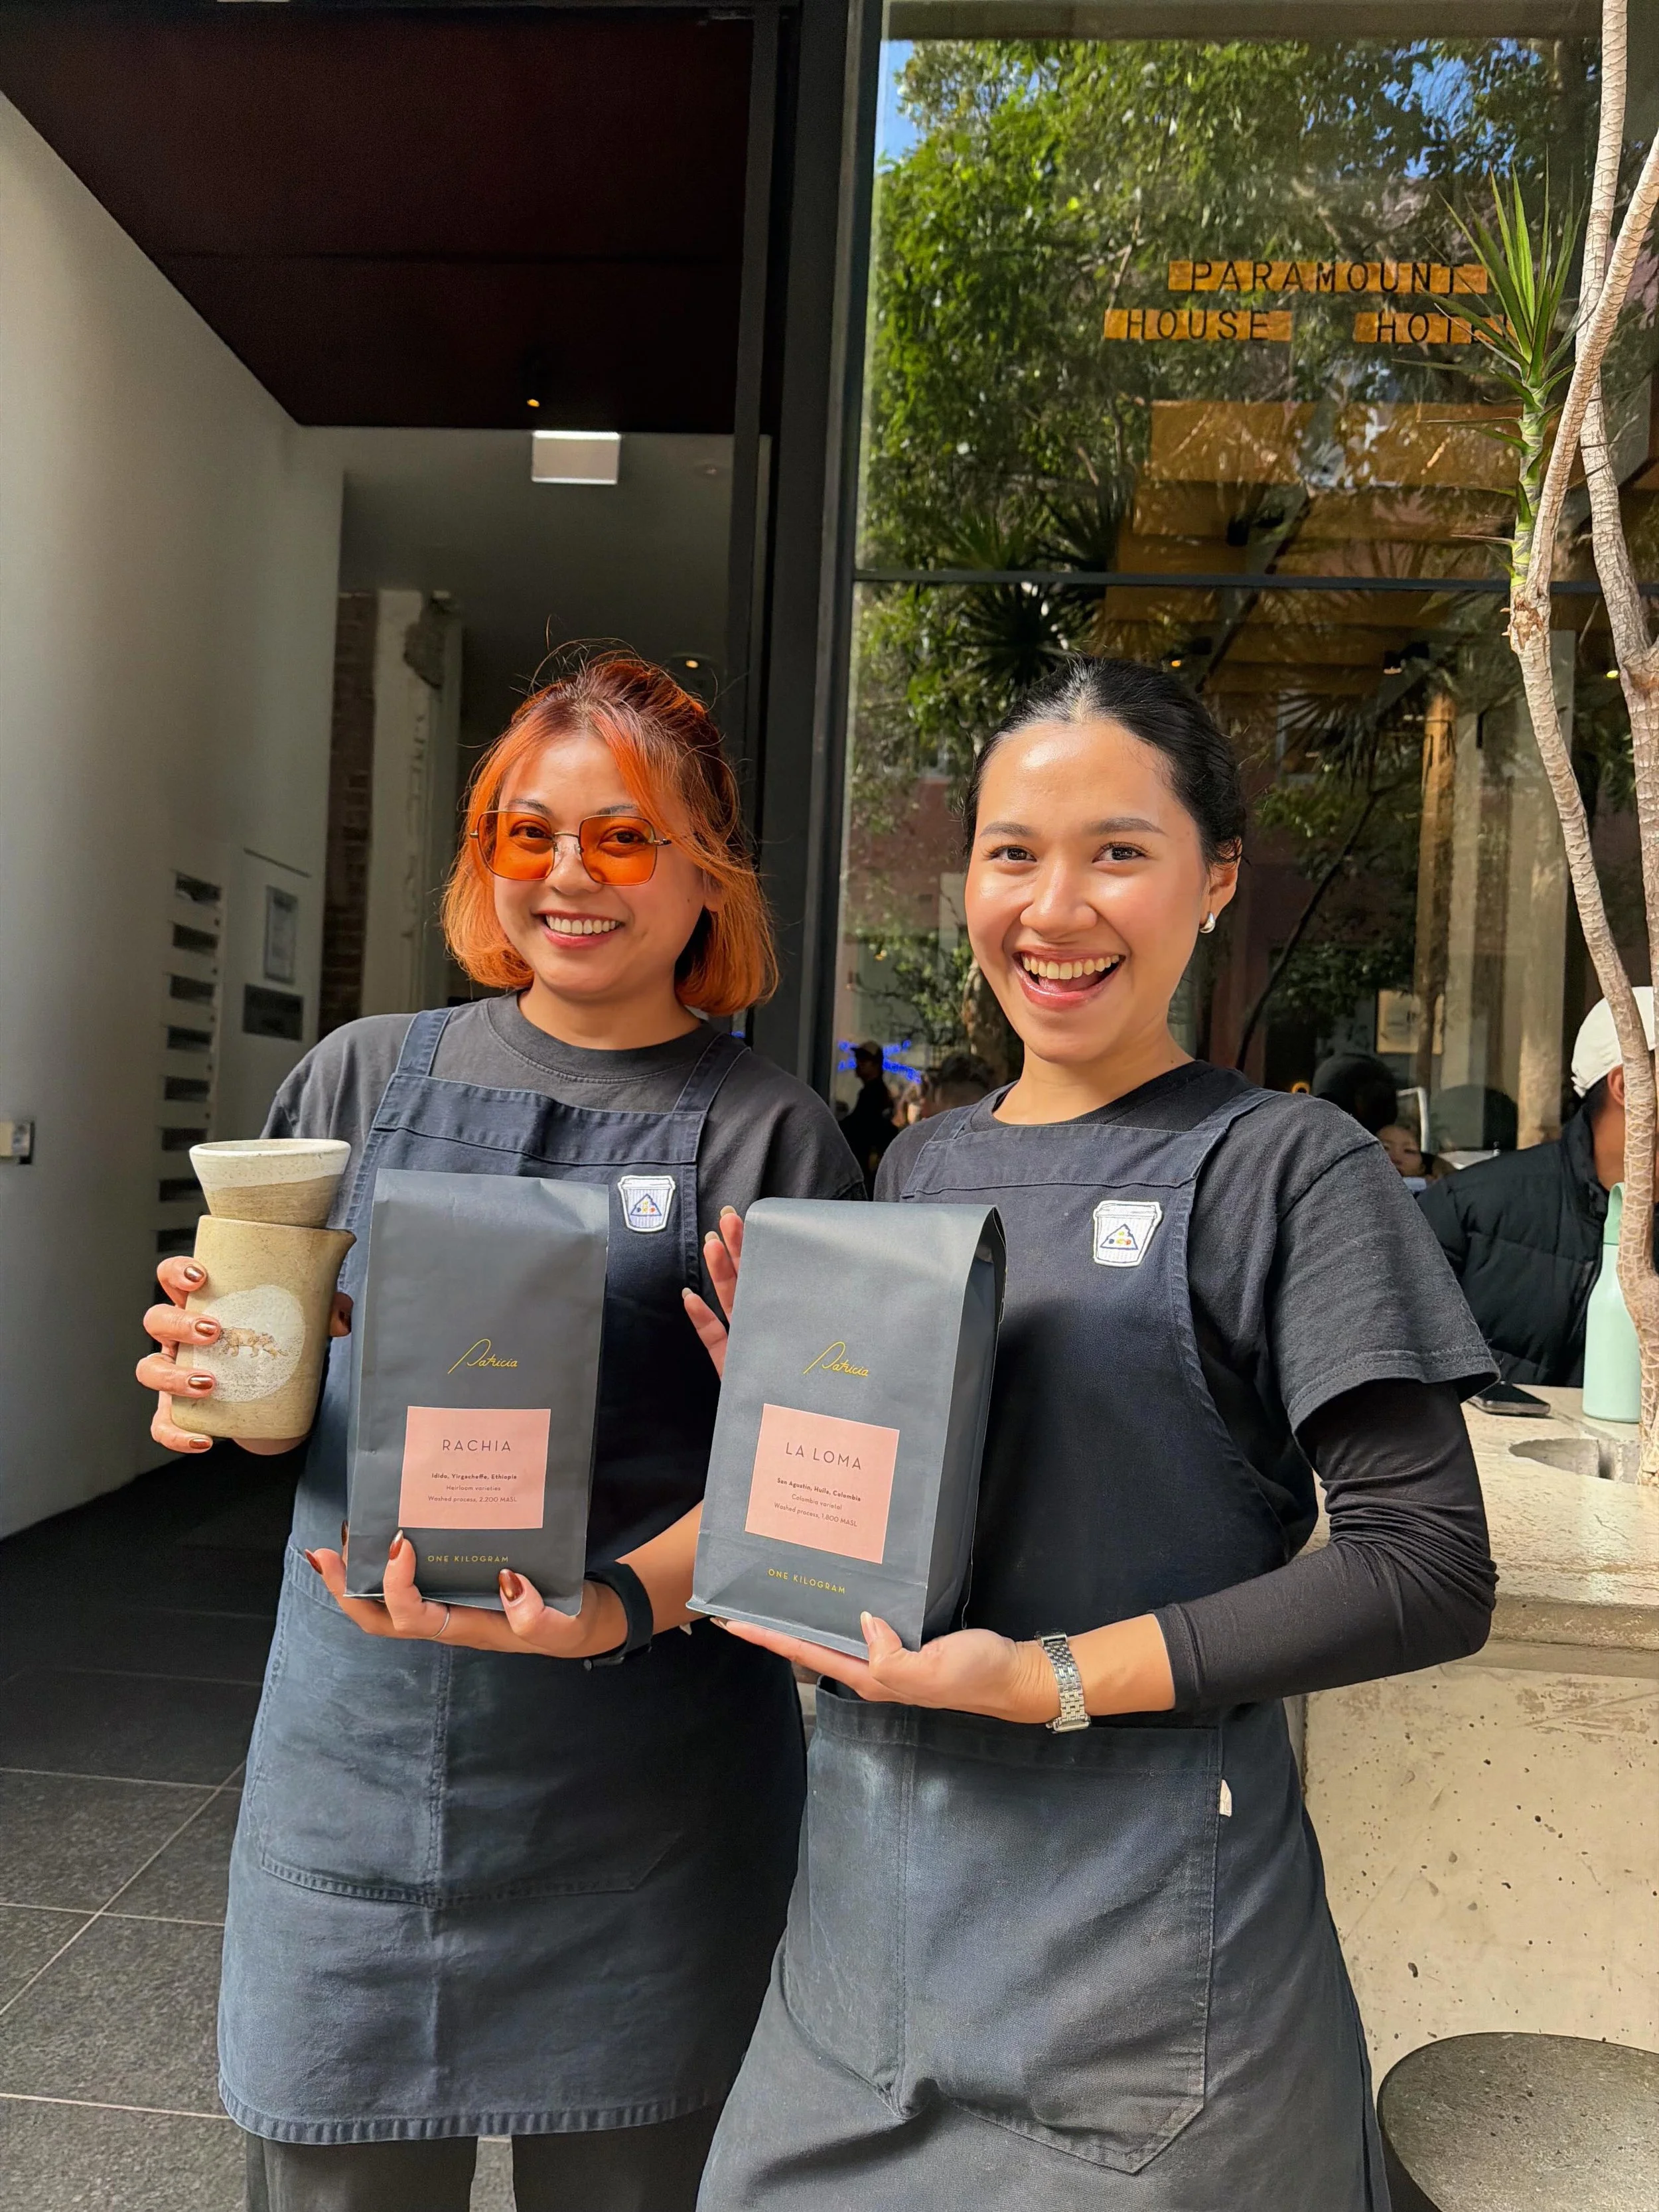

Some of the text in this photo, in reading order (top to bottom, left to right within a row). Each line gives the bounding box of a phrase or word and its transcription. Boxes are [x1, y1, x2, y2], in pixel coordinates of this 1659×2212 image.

[1192, 261, 1467, 294] PARAMOUNT
[1127, 309, 1510, 344] HOUSE HOT
[447, 1338, 518, 1374] Patricia
[803, 1341, 869, 1376] Patricia
[442, 1439, 511, 1451] RACHIA
[786, 1441, 861, 1470] LA LOMA
[791, 1493, 842, 1511] Colombia varietal
[814, 1486, 831, 1496] Huila,
[833, 1490, 861, 1502] Colombia
[774, 1502, 857, 1527] Washed process, 1,800 MASL
[768, 1568, 845, 1594] ONE KILOGRAM
